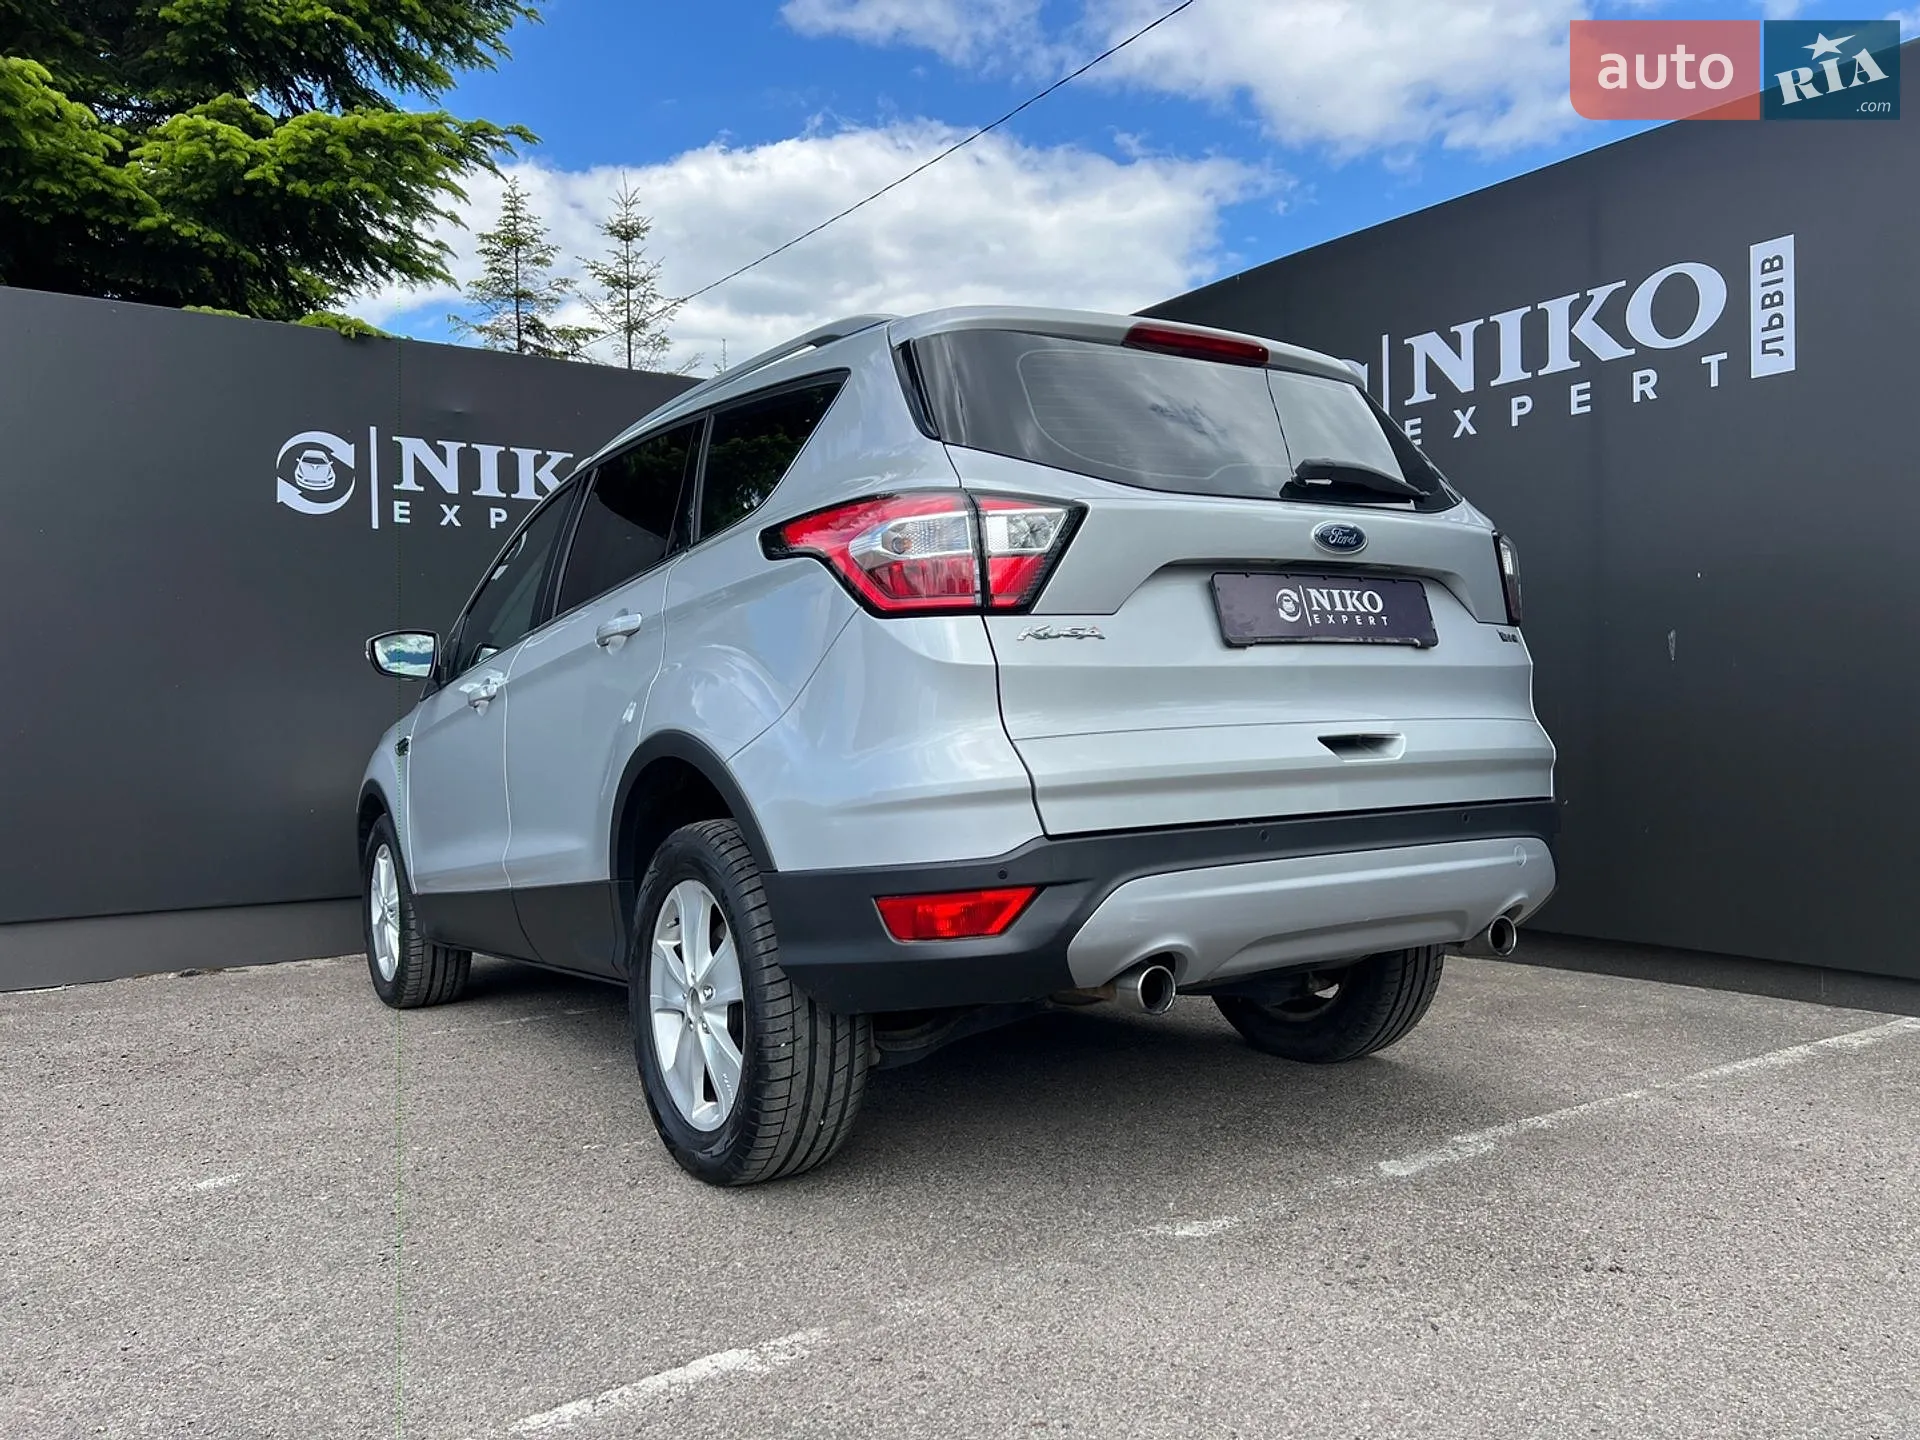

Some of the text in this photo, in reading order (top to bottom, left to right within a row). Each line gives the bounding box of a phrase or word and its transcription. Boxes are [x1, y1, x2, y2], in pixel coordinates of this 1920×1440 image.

[1760, 254, 1785, 357] ЛЬВІВ
[1403, 261, 1728, 407] NIKO
[1404, 351, 1728, 446] EXPERT
[392, 436, 592, 501] NIK
[393, 500, 508, 529] EXP
[1328, 527, 1358, 545] Ford
[1306, 588, 1384, 613] NIKO
[1313, 614, 1388, 626] EXPERT
